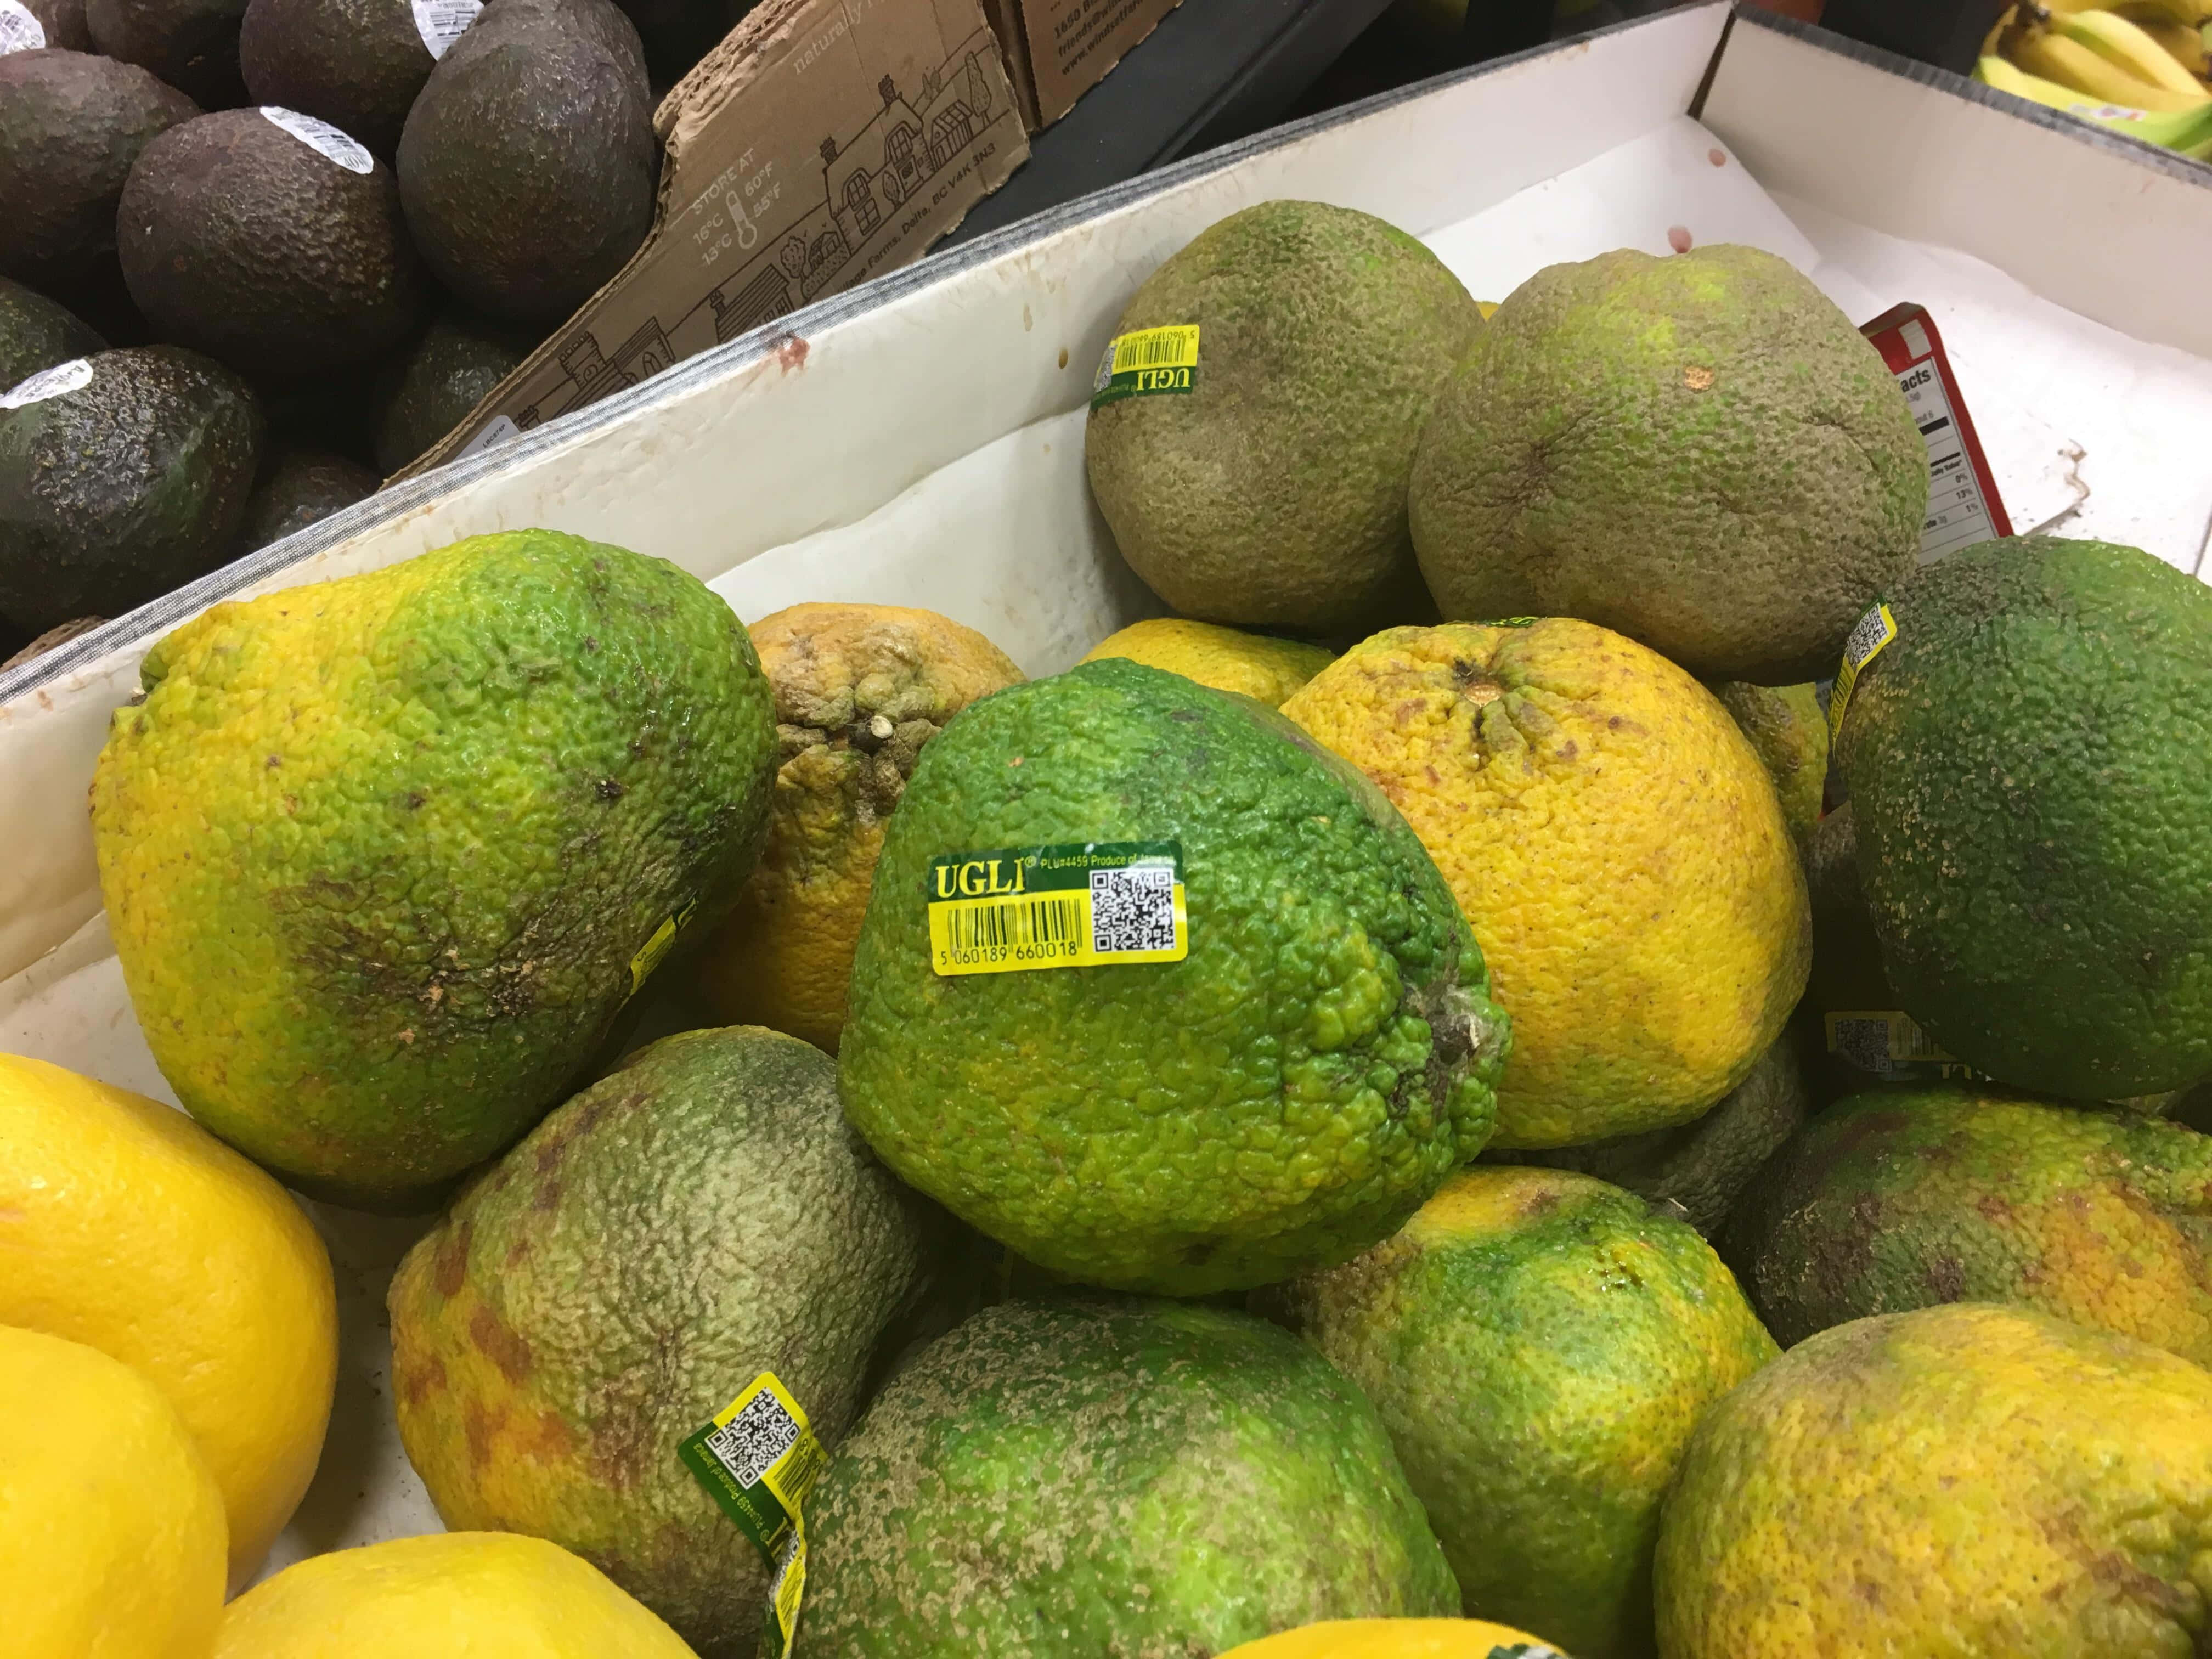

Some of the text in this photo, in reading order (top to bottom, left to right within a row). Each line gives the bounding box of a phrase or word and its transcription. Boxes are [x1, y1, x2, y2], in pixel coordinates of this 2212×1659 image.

[693, 148, 754, 215] STORE AT
[745, 161, 772, 197] 60°F
[867, 236, 901, 268] Farms,
[901, 208, 932, 235] Delta,
[933, 187, 949, 206] BC
[948, 163, 972, 189] V4K
[972, 142, 996, 167] 3N3
[693, 213, 723, 245] 16°C
[702, 233, 732, 266] 13°C
[1136, 368, 1190, 391] UGLI
[1900, 370, 1931, 392] acts
[1091, 855, 1126, 866] Produce
[1128, 853, 1137, 865] of
[941, 941, 1077, 966] 5 060189 660018
